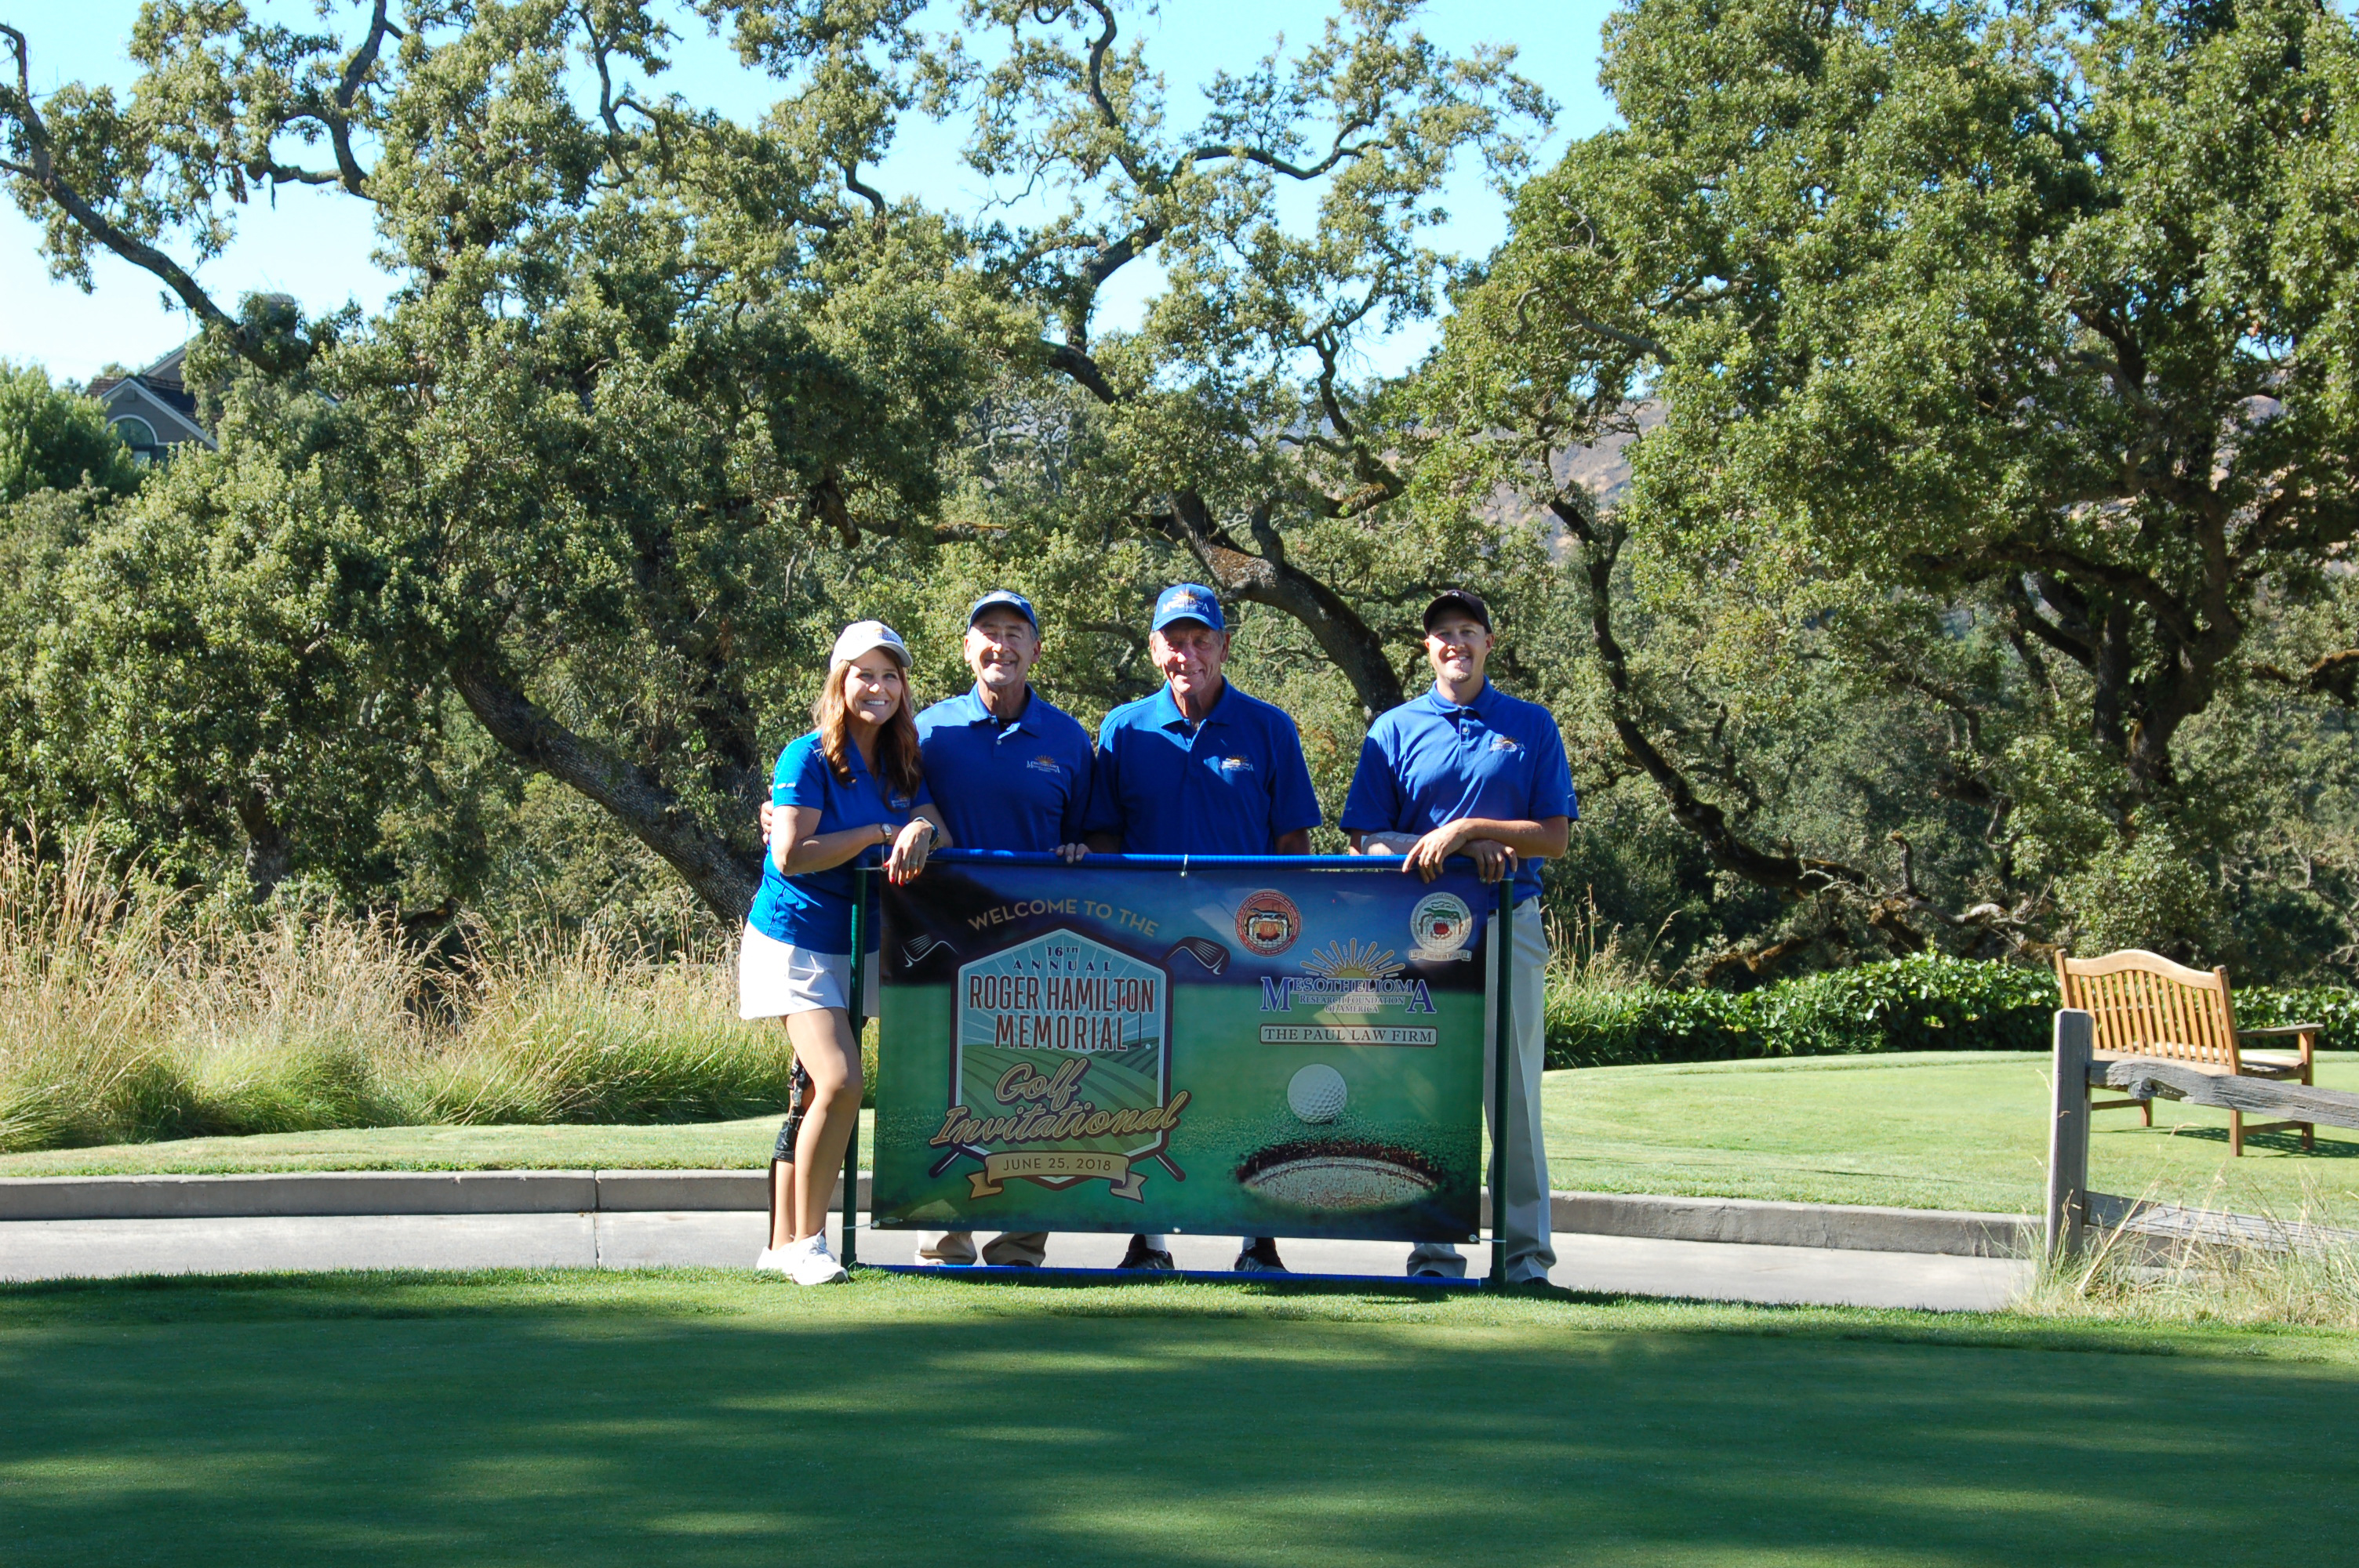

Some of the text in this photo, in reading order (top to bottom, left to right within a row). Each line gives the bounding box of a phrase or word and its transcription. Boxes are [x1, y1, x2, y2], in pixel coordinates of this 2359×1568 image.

[967, 899, 1159, 938] WELCOME TO THE
[1046, 946, 1078, 957] 16TH
[1012, 960, 1112, 971] ANNUAL
[969, 975, 1154, 1014] ROGER HAMILTON
[1259, 976, 1437, 1014] MESOTHELIOMA
[1299, 994, 1405, 1005] RESEARCH FOUNDATION
[1325, 1004, 1379, 1013] OF AMERICA
[994, 1014, 1129, 1051] MEMORIAL
[1265, 1028, 1433, 1043] THE PAUL LAW FIRM
[995, 1058, 1089, 1112] Golf
[929, 1091, 1190, 1146] Invitational
[1003, 1158, 1111, 1171] JUNE 25, 2018
